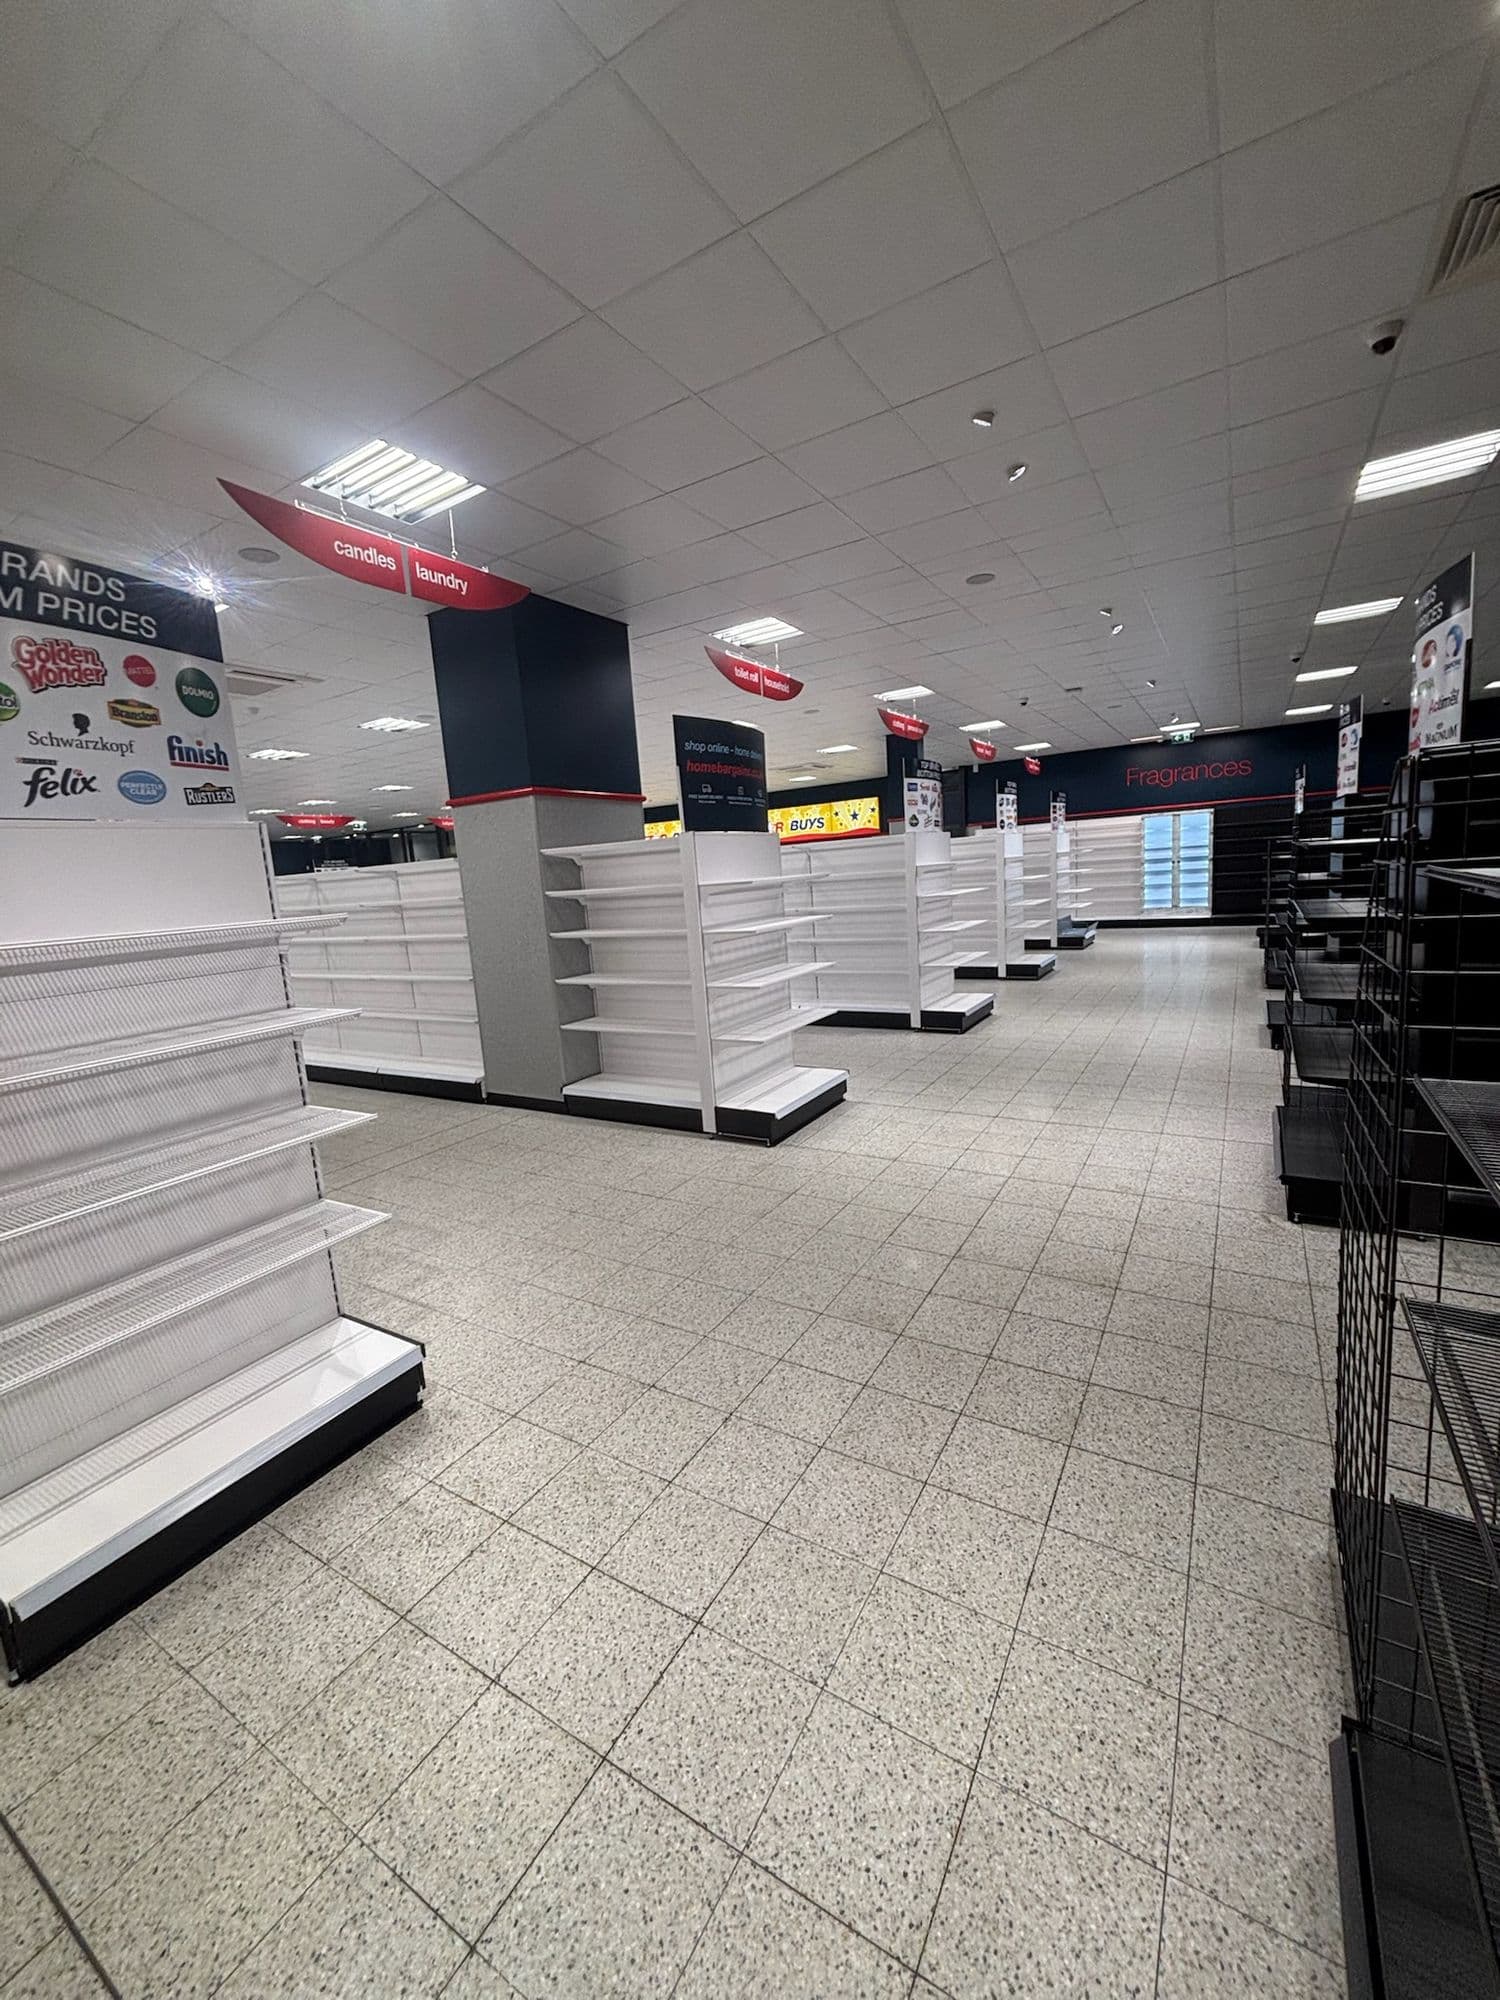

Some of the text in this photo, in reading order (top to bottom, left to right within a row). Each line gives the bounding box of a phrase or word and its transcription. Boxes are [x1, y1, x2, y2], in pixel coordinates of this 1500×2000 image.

[333, 539, 396, 571] candles
[415, 561, 468, 596] laundry
[37, 591, 157, 640] PRICES
[13, 637, 99, 668] Golden
[13, 660, 106, 692] Wonder
[182, 685, 214, 700] DOLMIO
[112, 706, 158, 721] Branston
[27, 730, 136, 757] Schwarzkopf
[167, 735, 229, 767] finish
[684, 740, 707, 754] shop
[707, 743, 730, 754] online
[22, 767, 101, 808] felix
[1125, 759, 1254, 788] Fragrances
[129, 788, 158, 796] CLEAR
[186, 788, 235, 804] RUSTLERS
[790, 816, 825, 831] BUYS
